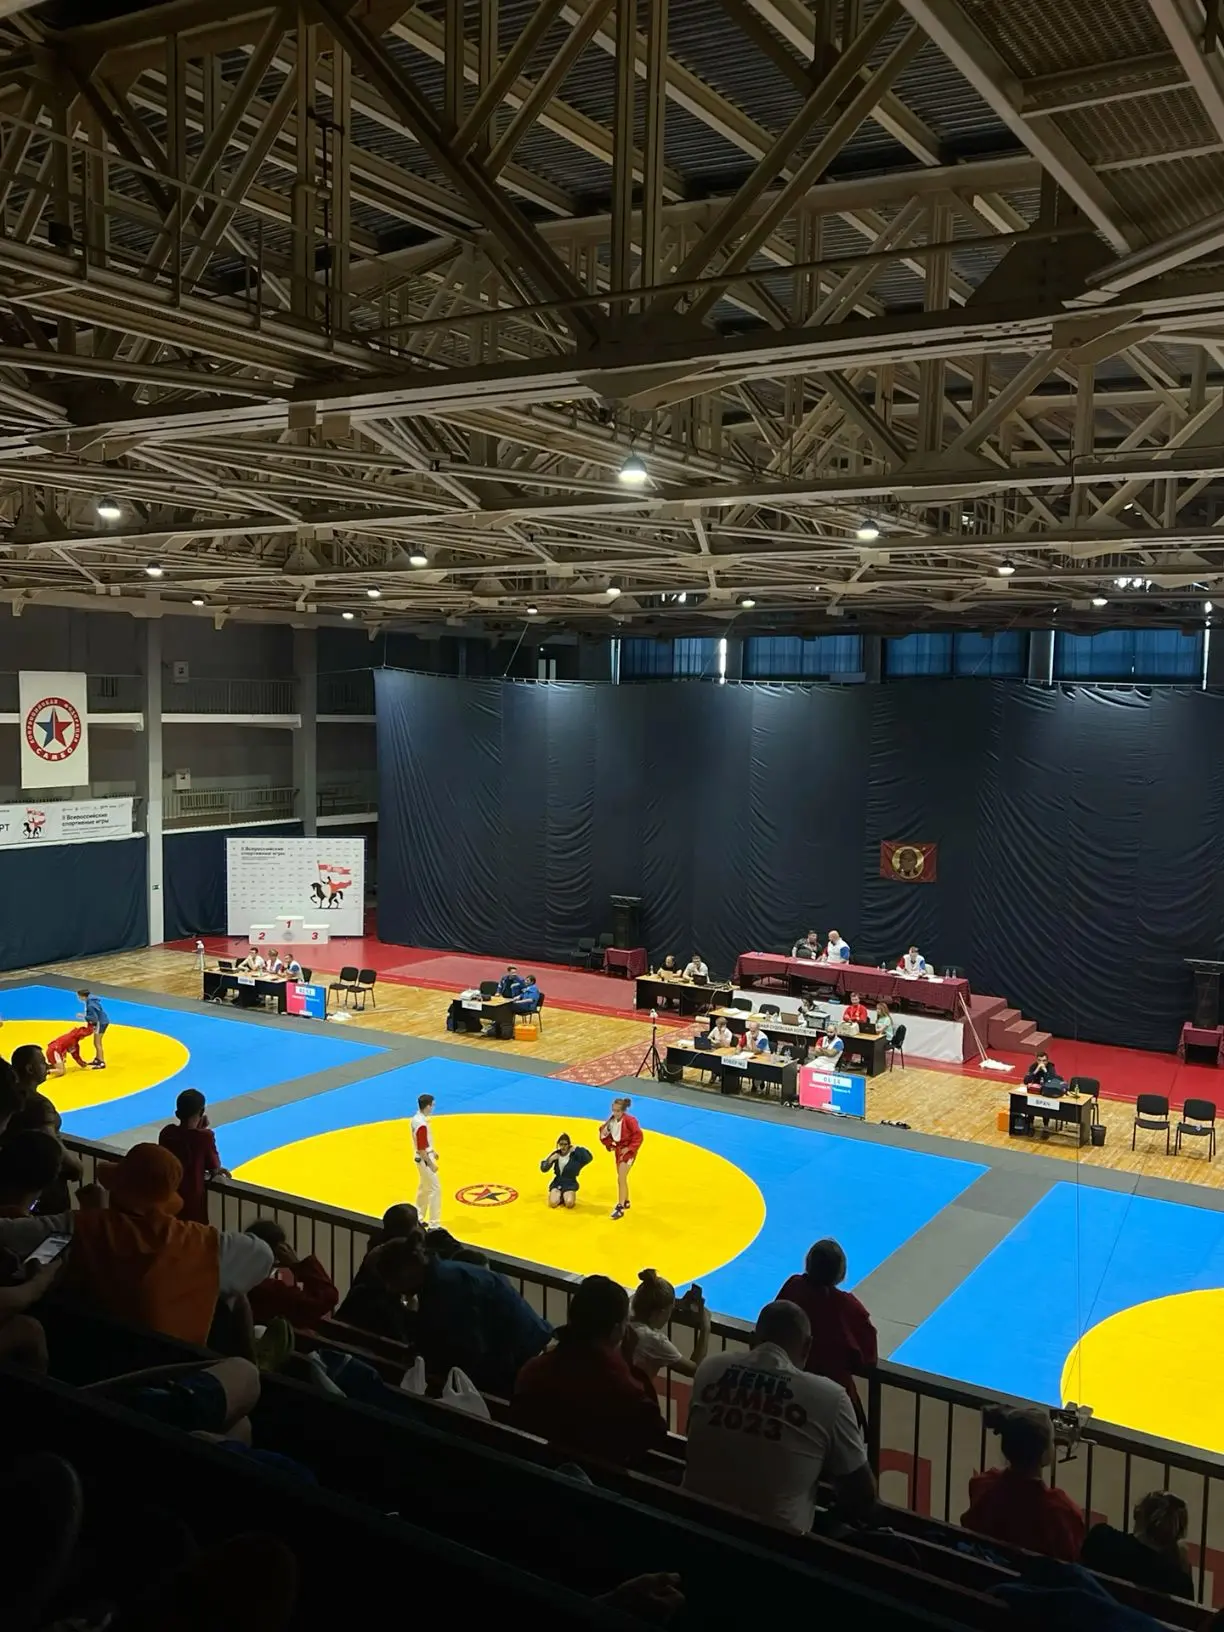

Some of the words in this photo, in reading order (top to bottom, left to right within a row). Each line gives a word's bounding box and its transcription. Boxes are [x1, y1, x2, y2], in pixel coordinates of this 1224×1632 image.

[36, 747, 73, 760] САМБО
[66, 812, 108, 821] Всероссийские
[0, 823, 10, 832] РТ
[62, 819, 95, 827] спортивные
[286, 920, 292, 928] 1
[258, 932, 266, 940] 2
[311, 932, 319, 940] 3
[717, 1367, 794, 1399] ДЕНЬ
[701, 1382, 807, 1428] САМБО
[708, 1404, 782, 1441] 2023
